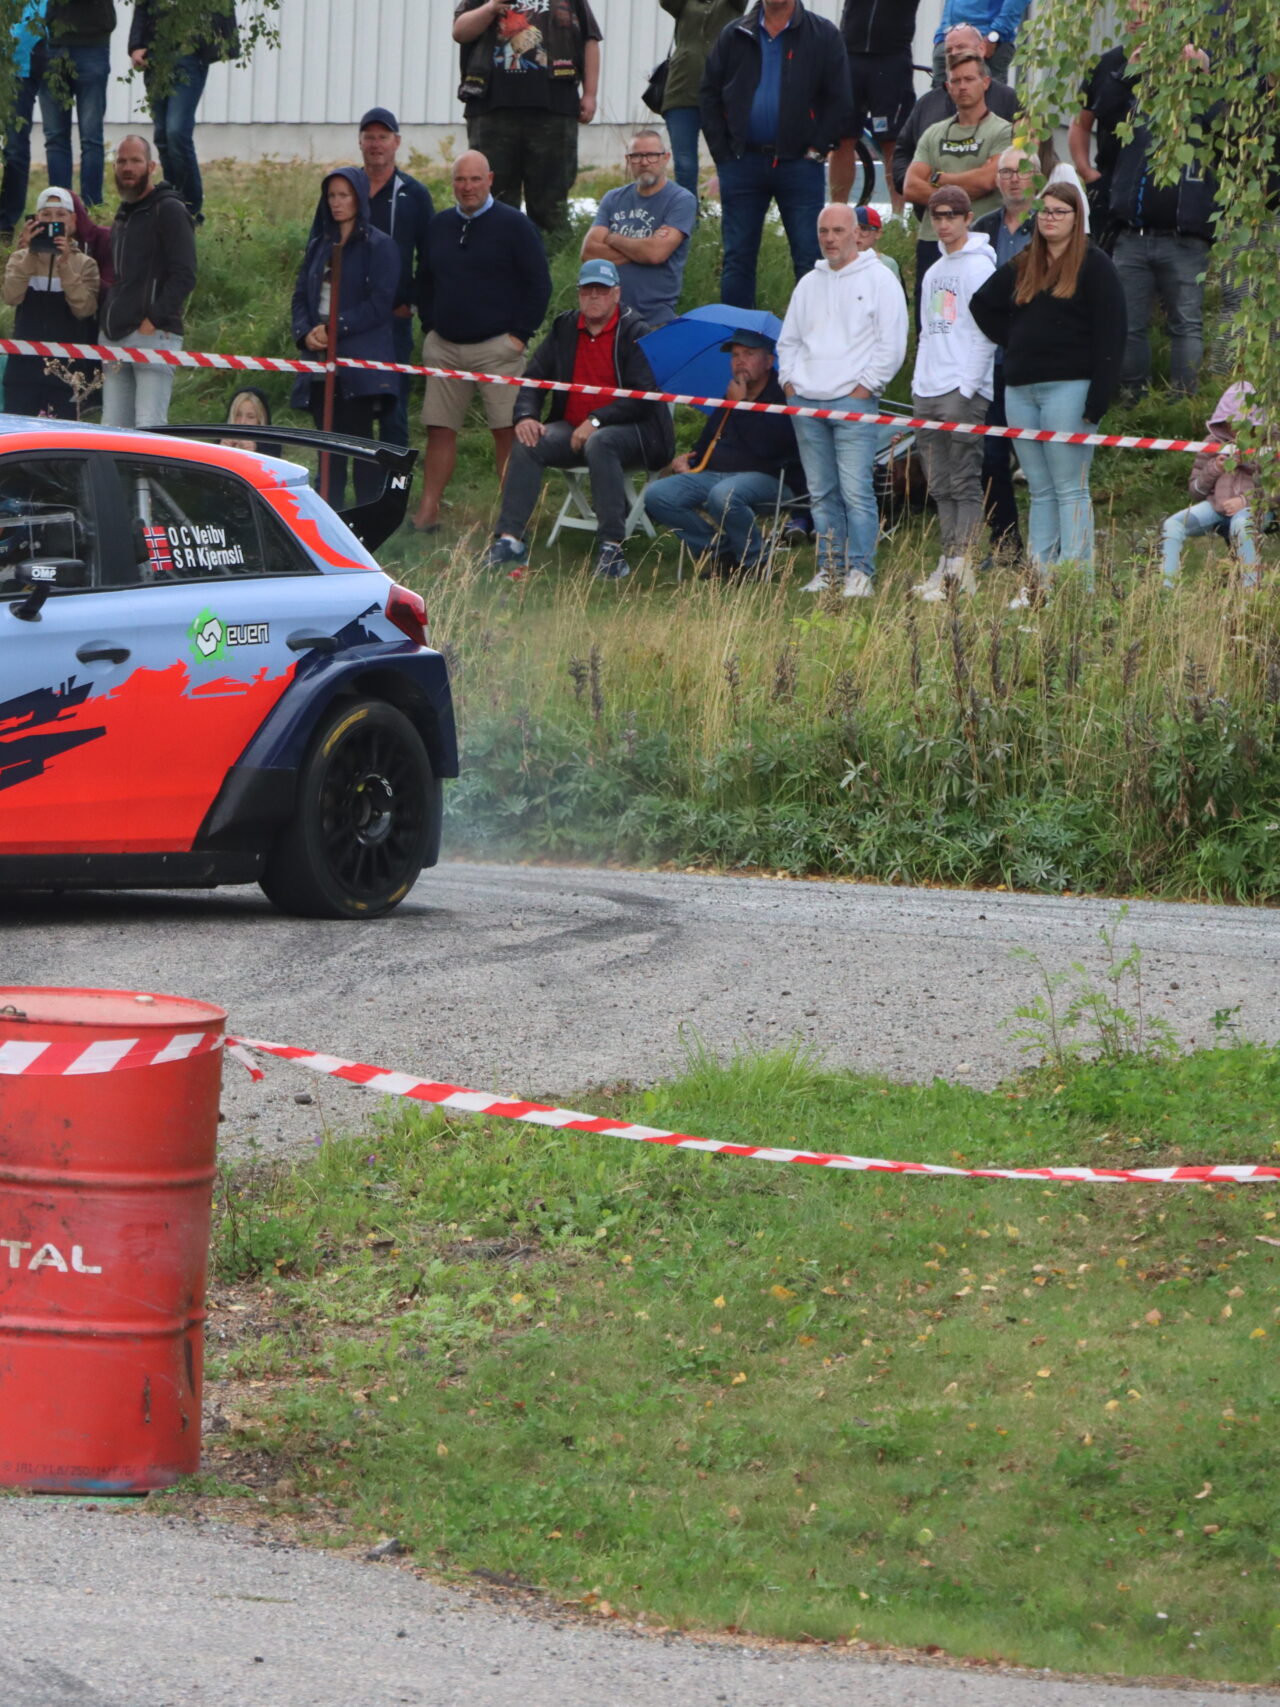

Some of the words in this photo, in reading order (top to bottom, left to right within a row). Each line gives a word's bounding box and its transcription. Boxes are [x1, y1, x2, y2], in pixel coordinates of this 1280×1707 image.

[168, 526, 179, 547] O
[180, 526, 191, 546] C
[191, 525, 226, 548] Veiby
[173, 548, 184, 569] S
[184, 548, 197, 567] R
[196, 545, 245, 571] Kjernsli
[32, 568, 56, 579] OMP
